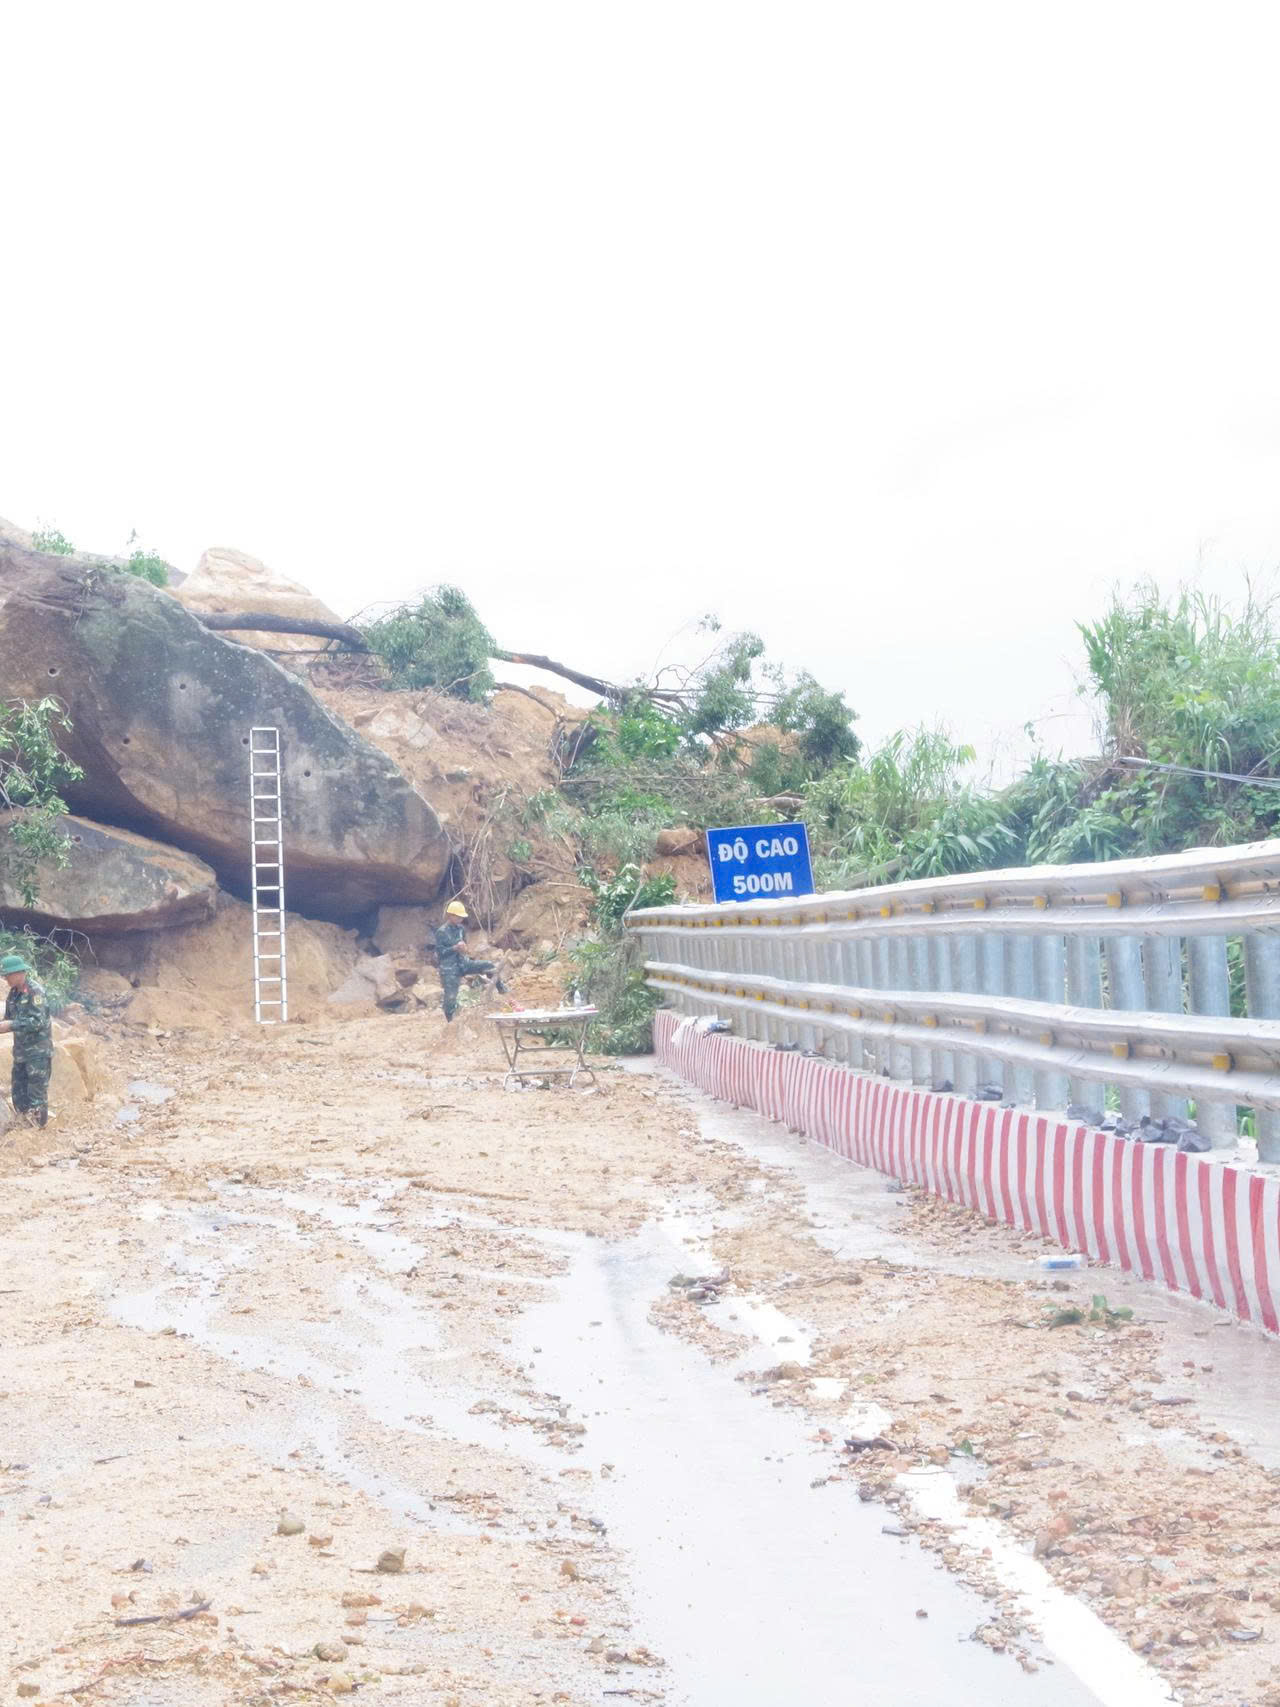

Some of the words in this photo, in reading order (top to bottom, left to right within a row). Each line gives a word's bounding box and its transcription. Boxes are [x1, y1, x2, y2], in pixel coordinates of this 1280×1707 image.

[718, 837, 749, 864] ĐỘ
[755, 837, 799, 858] CAO
[733, 872, 793, 894] 500M
